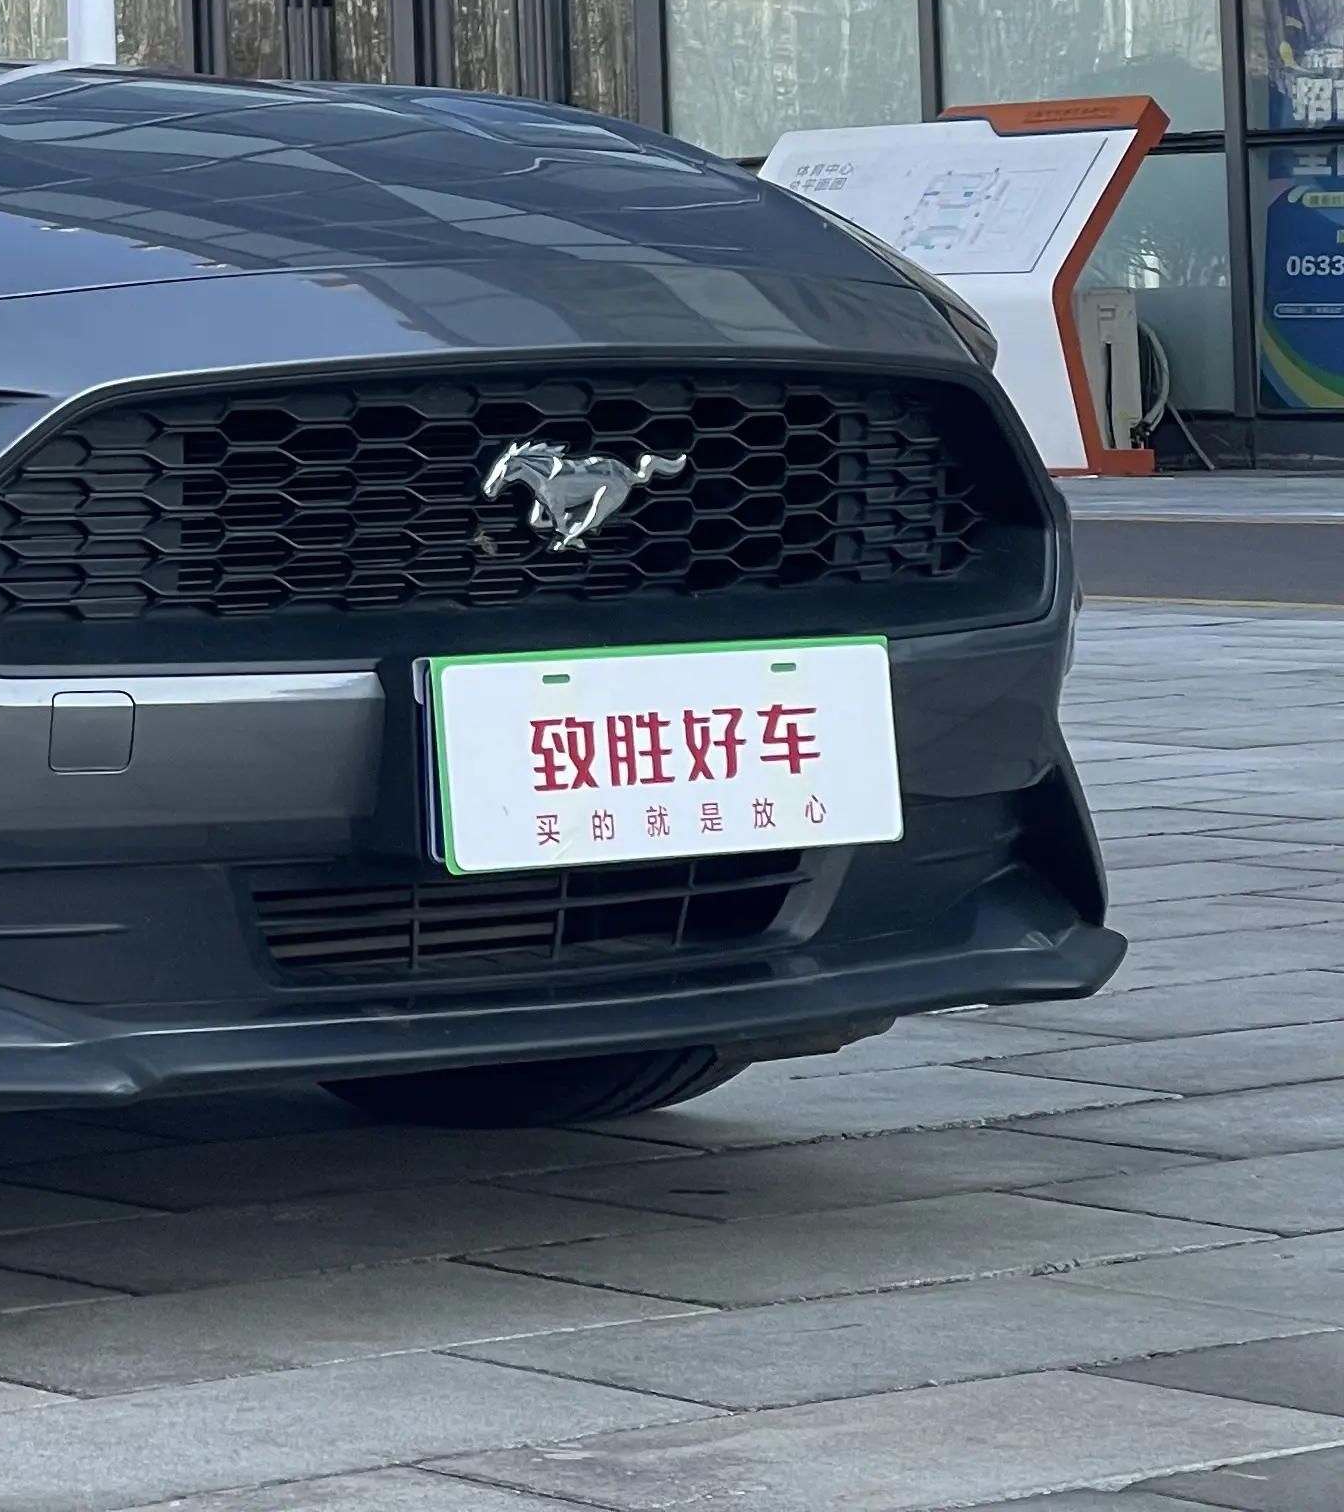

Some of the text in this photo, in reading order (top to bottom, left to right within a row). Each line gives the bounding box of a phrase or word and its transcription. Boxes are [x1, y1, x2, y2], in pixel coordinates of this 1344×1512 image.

[529, 704, 821, 791] 致胜好车
[536, 795, 826, 846] 买的就是放心
